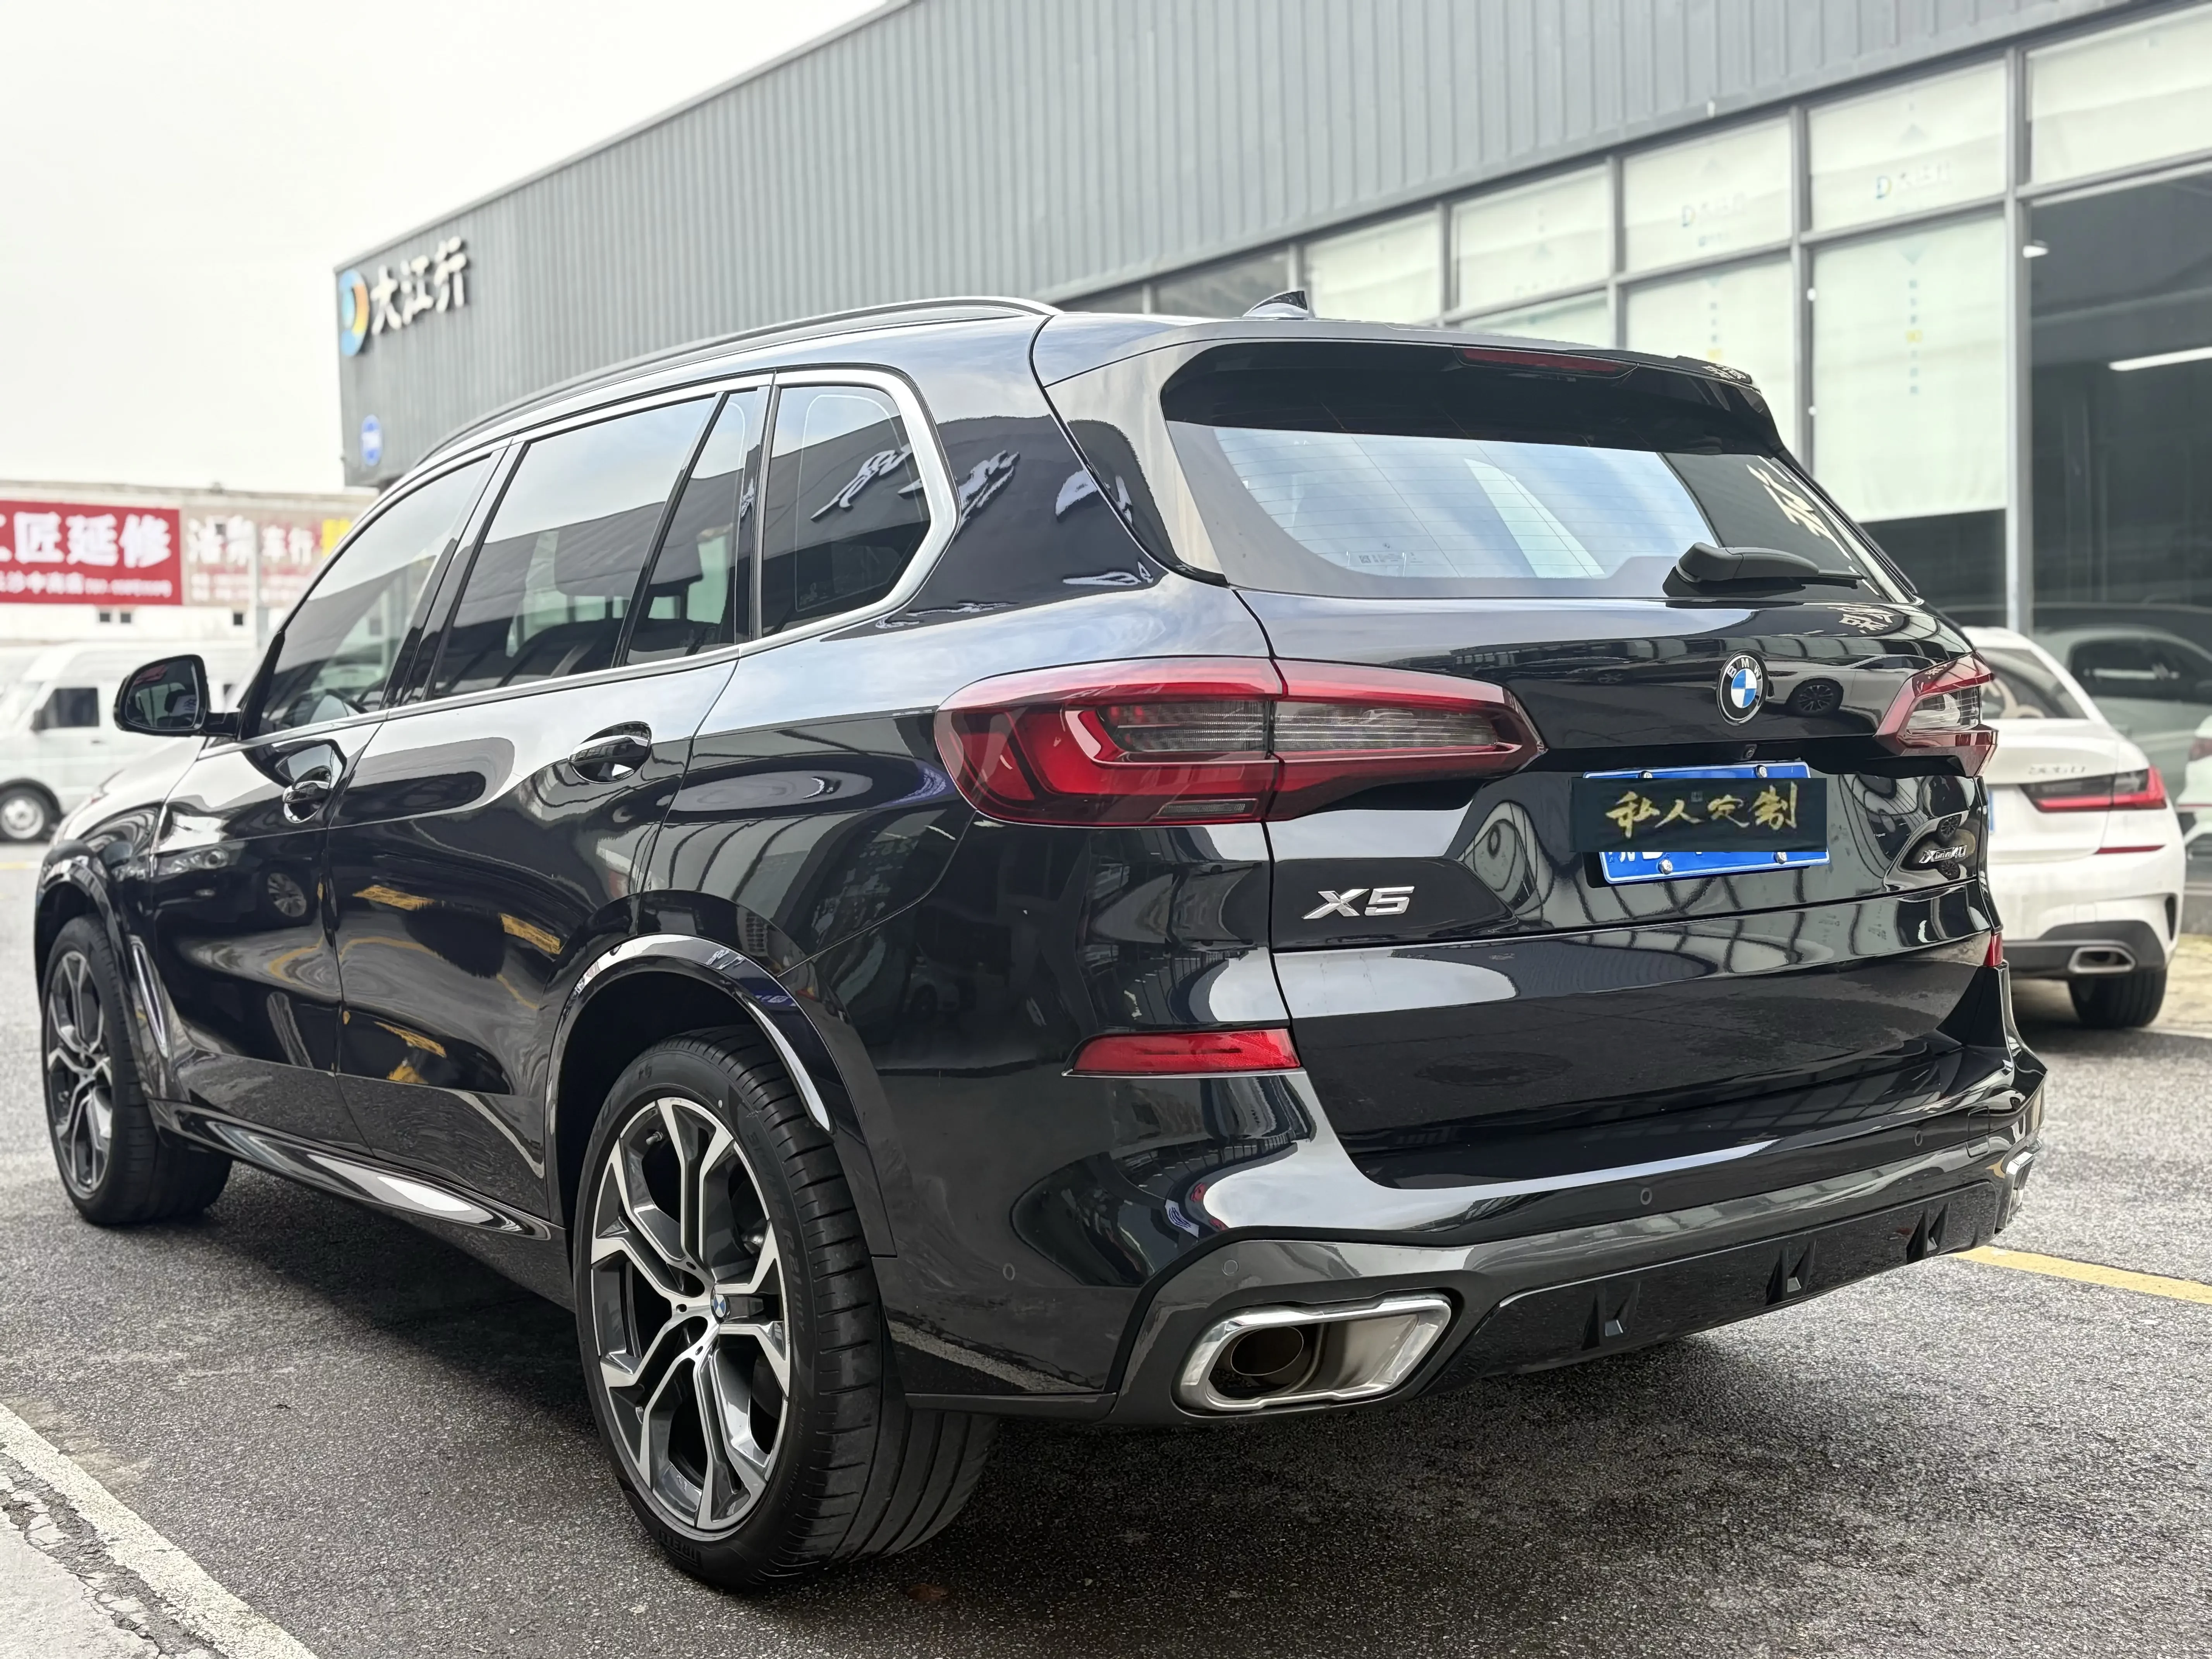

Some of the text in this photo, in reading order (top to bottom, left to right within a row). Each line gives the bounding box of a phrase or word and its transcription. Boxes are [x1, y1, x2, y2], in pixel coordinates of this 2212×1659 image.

[0, 512, 172, 568] 匠延修
[1727, 658, 1761, 680] BMW
[1302, 886, 1415, 920] X5
